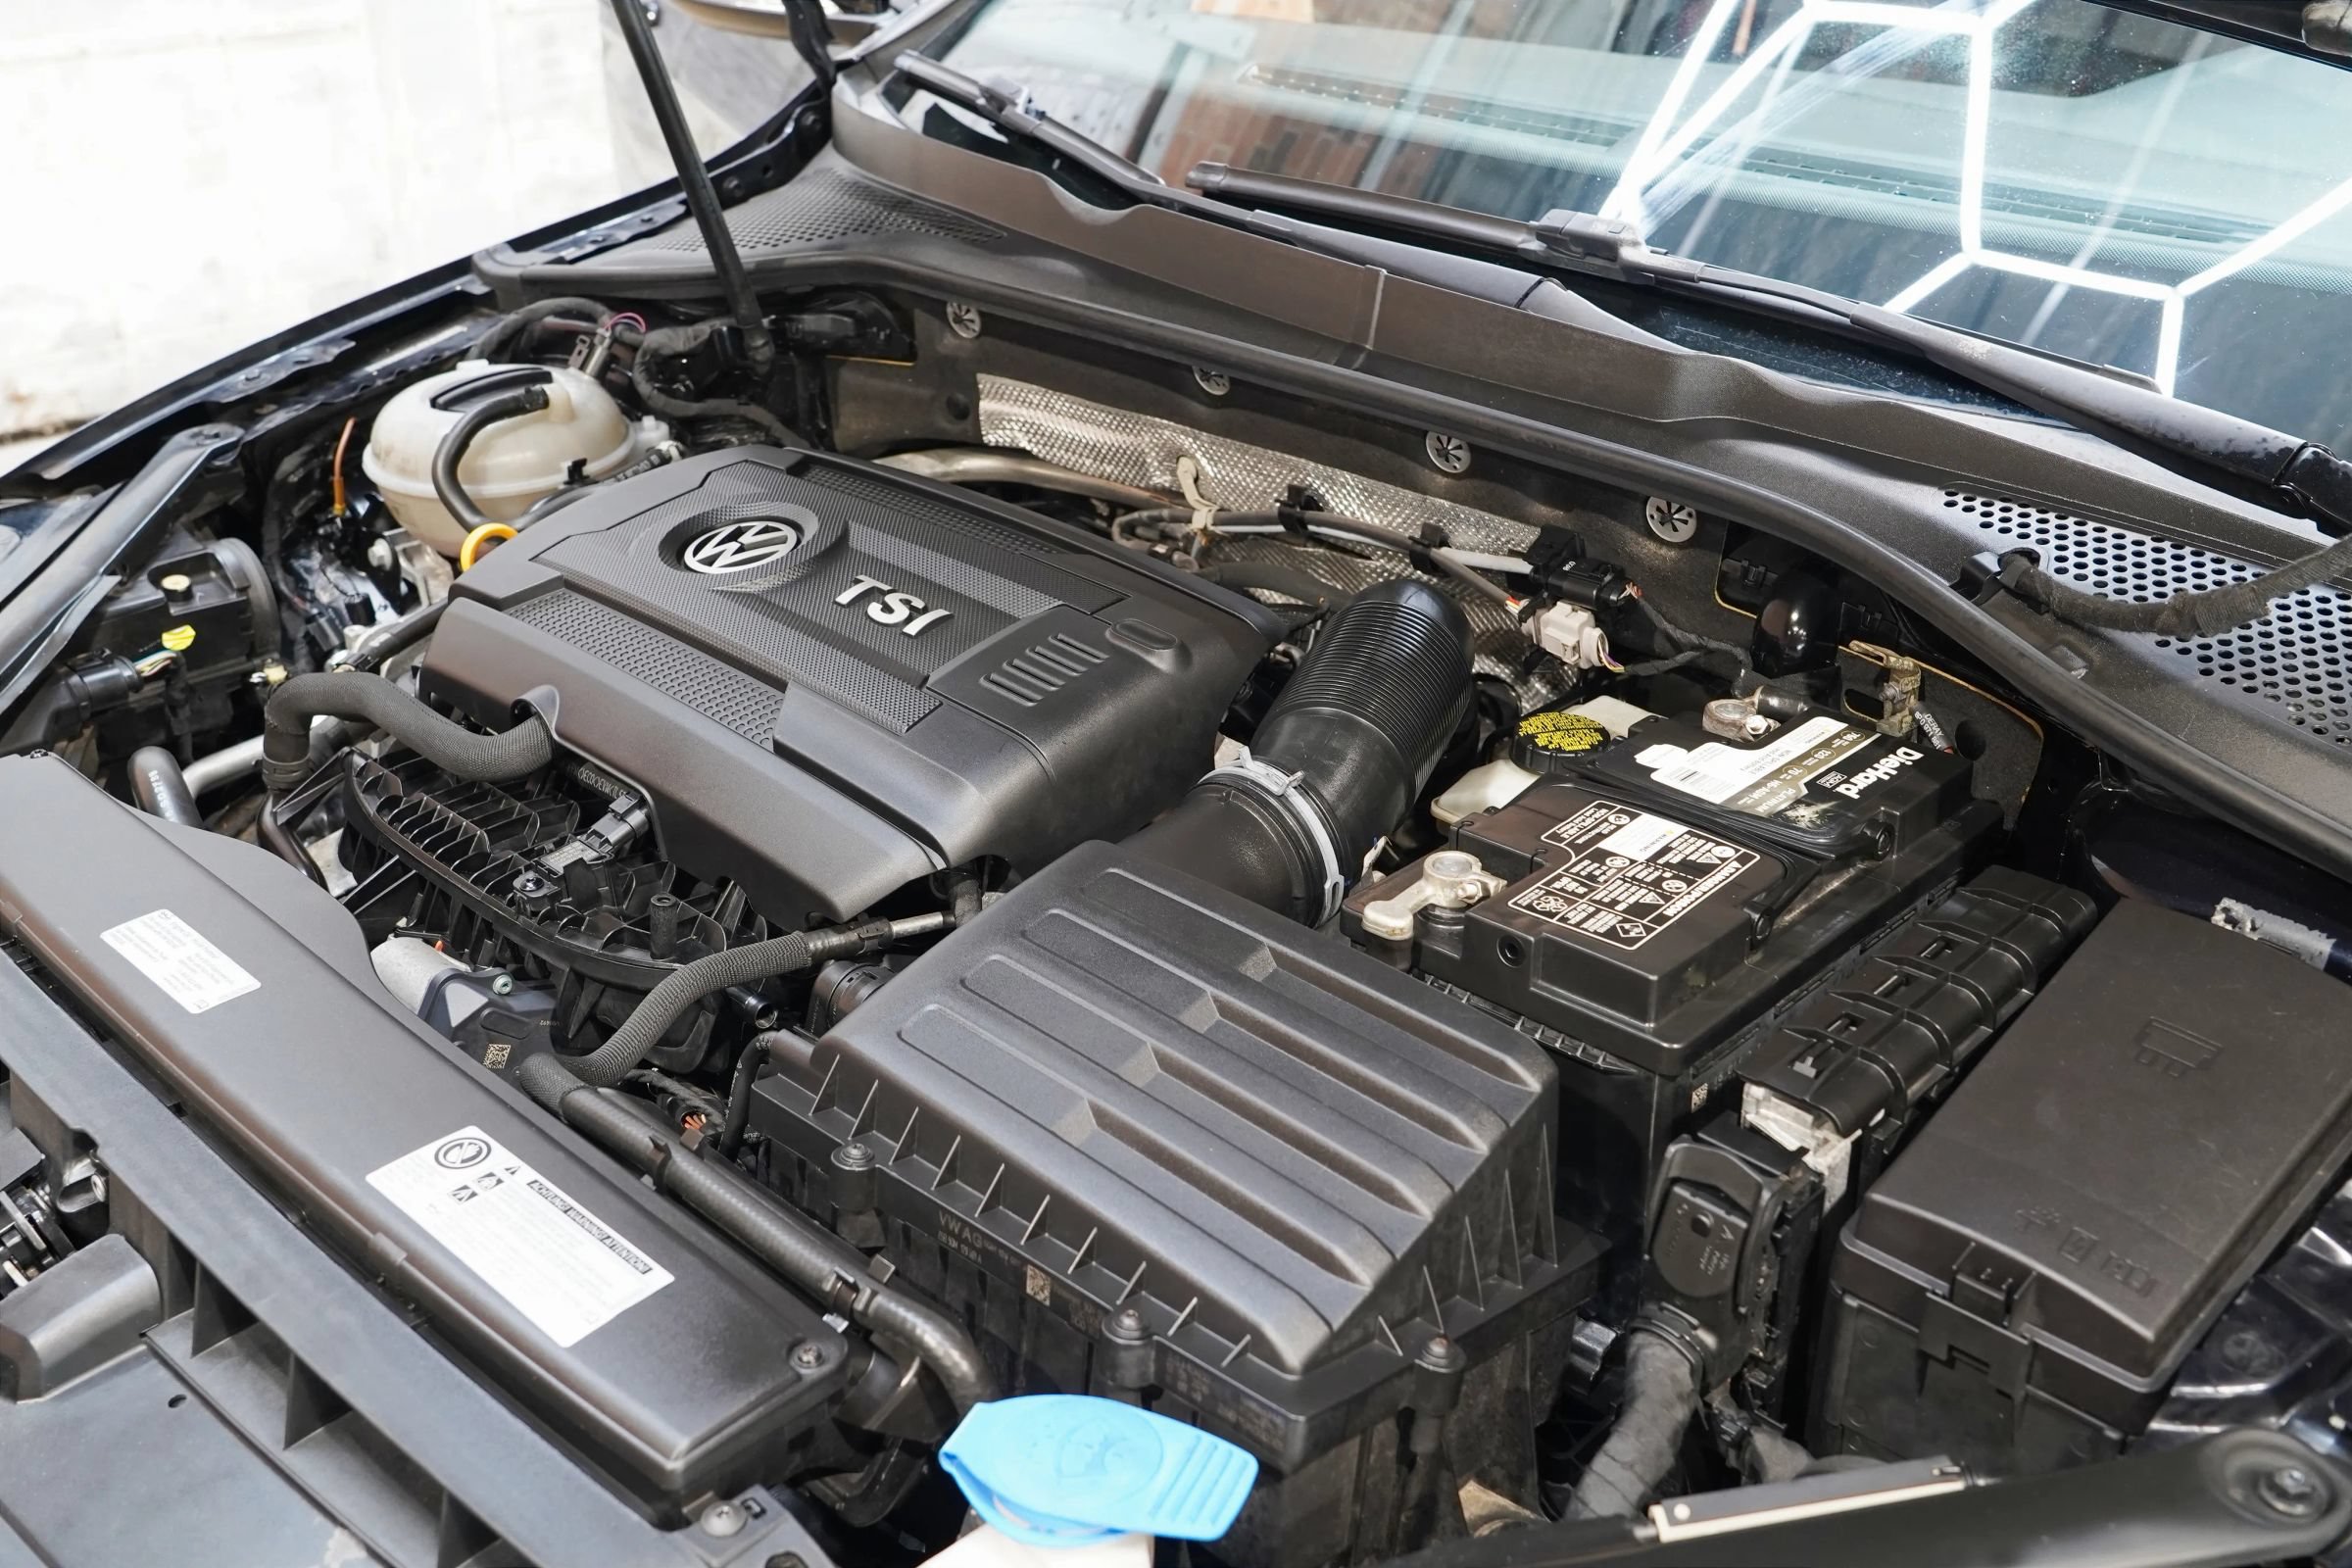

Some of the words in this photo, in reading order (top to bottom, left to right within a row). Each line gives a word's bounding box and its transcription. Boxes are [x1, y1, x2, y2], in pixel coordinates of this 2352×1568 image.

[834, 574, 955, 638] TSI
[1925, 713, 1944, 737] DERAY
[1814, 750, 1832, 759] 120
[1835, 747, 1924, 800] DieHard
[1754, 788, 1796, 811] PLATINUM
[939, 1208, 962, 1235] VW
[961, 1226, 985, 1249] AG
